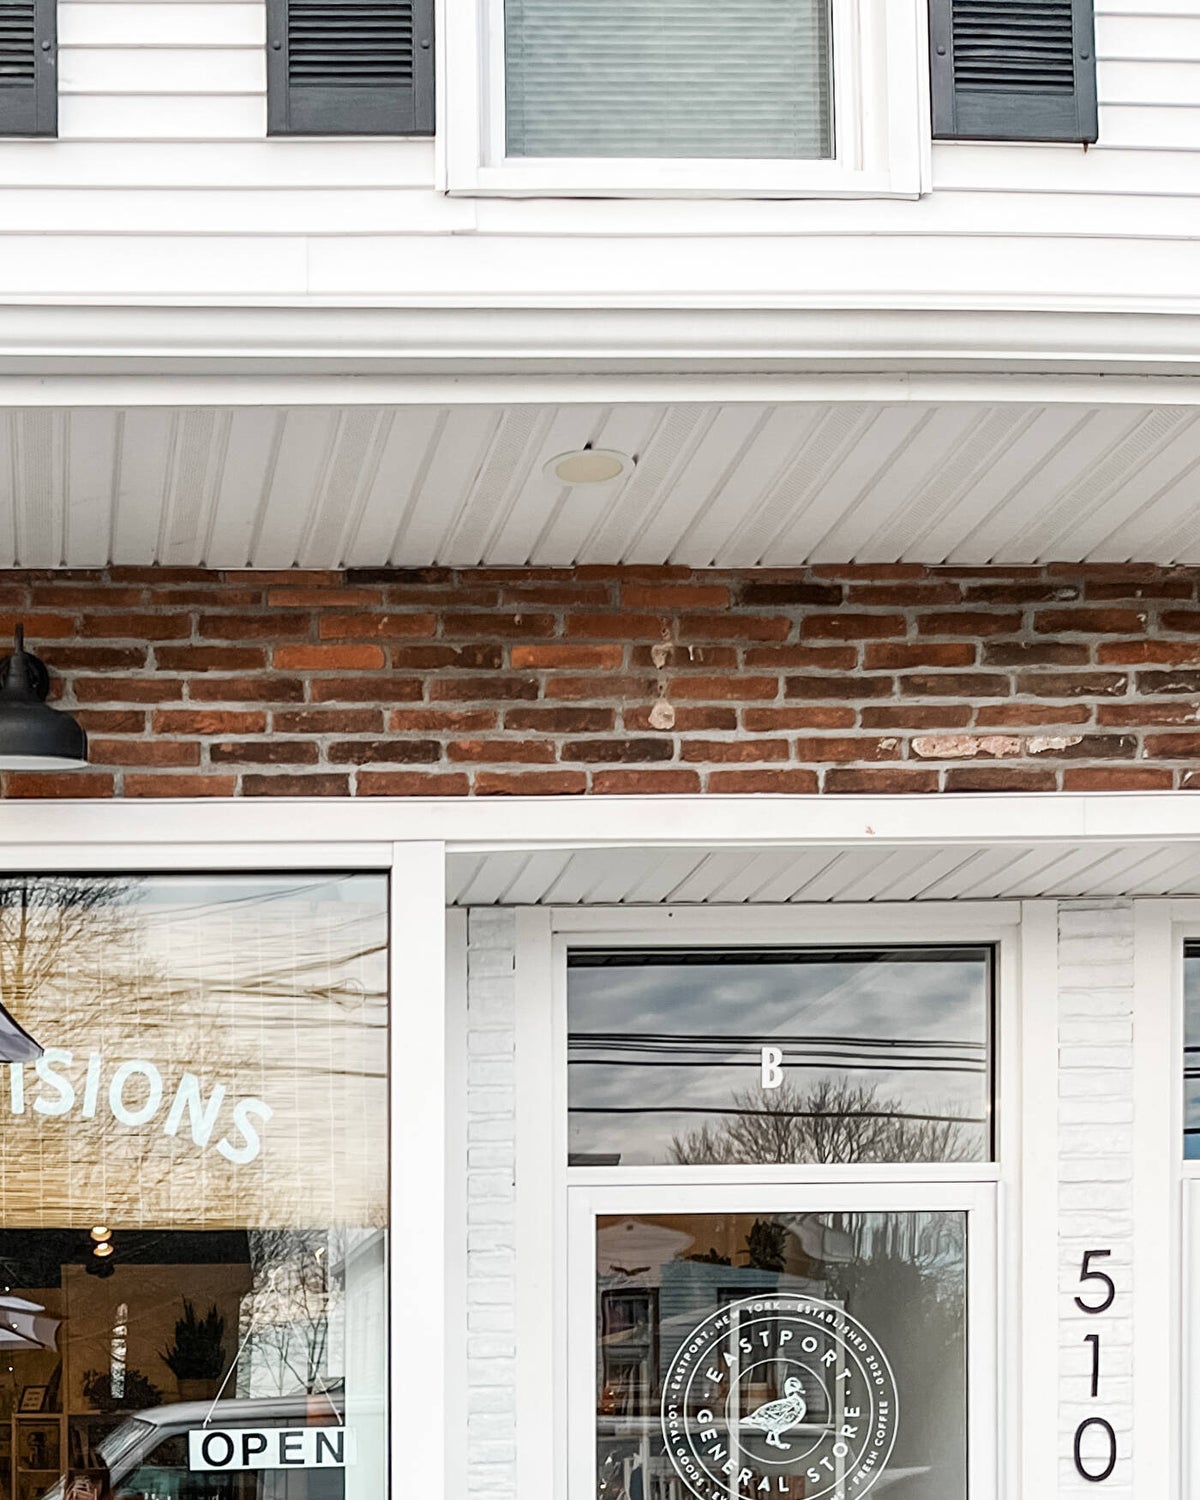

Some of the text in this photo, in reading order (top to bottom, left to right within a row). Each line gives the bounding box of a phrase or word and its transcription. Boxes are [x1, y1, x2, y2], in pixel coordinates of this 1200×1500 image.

[762, 1046, 783, 1088] B
[714, 1311, 740, 1330] NEW
[746, 1301, 780, 1314] YORK
[796, 1303, 884, 1386] ESTABLISHED 2020
[706, 1329, 852, 1384] EASTPORT
[202, 1431, 344, 1467] OPEN
[668, 1404, 704, 1487] LOCAL GOODS
[697, 1406, 861, 1492] GENERAL STORE
[853, 1401, 889, 1485] FRESH COFFEE
